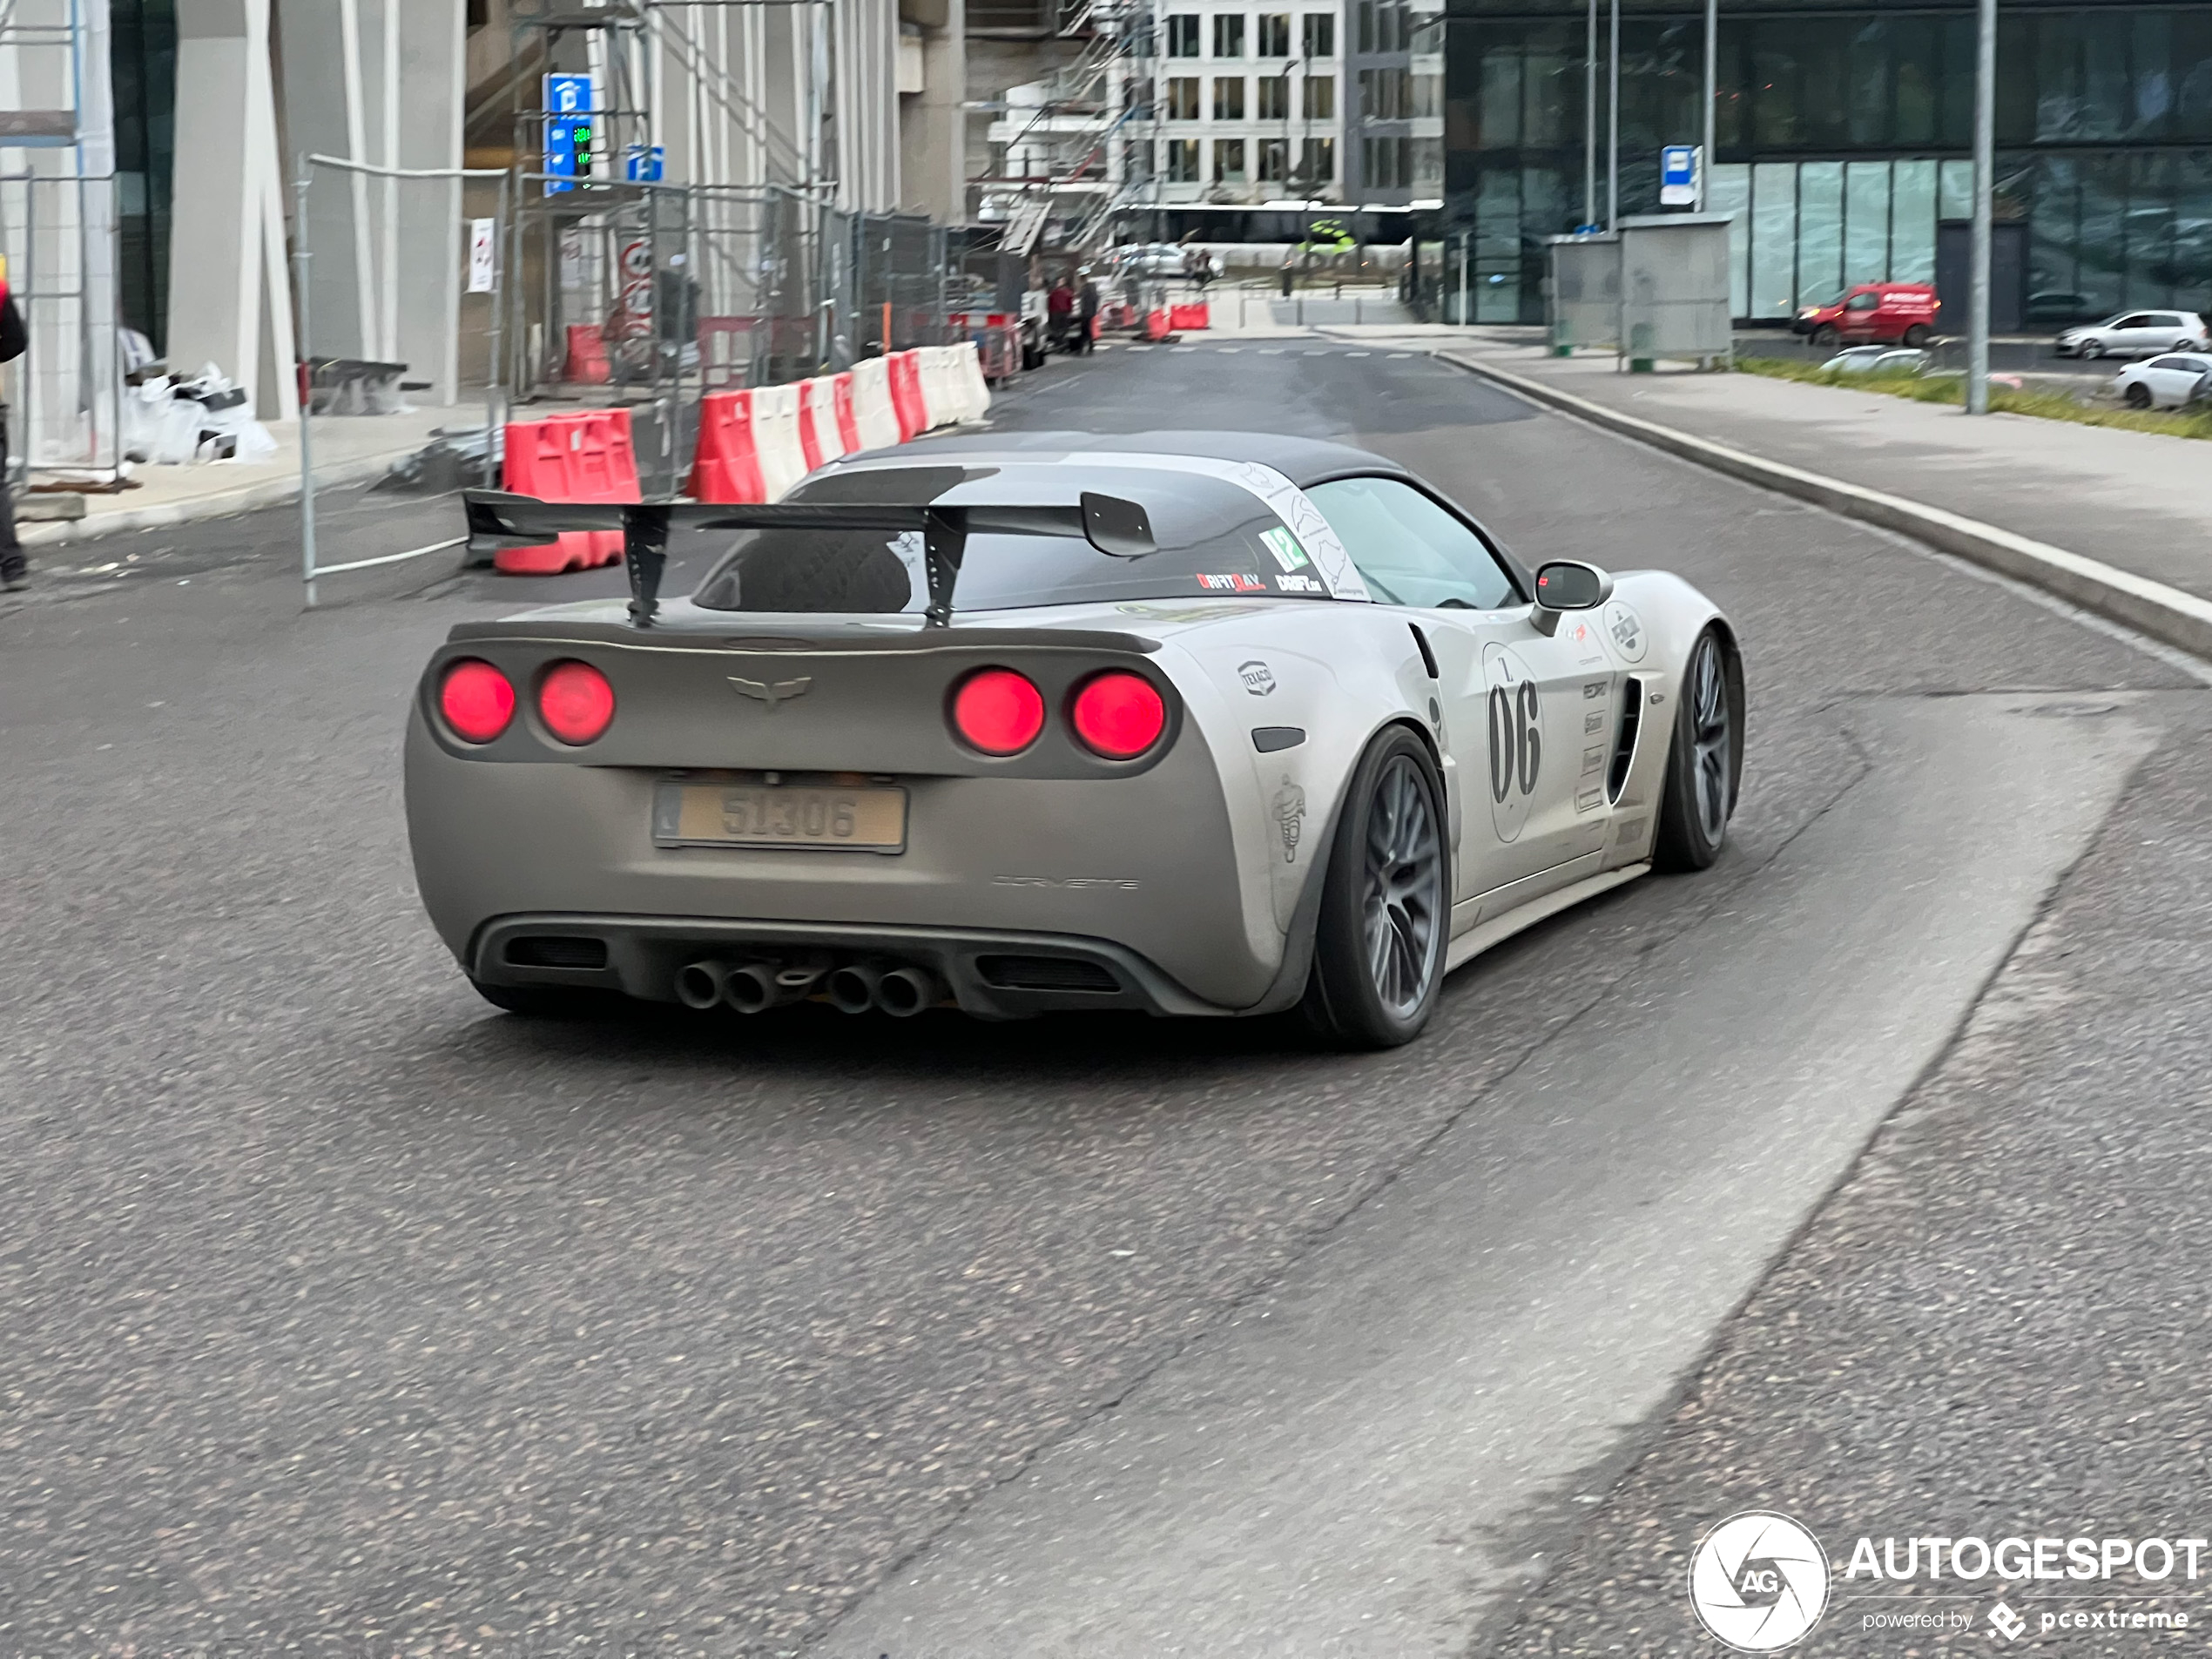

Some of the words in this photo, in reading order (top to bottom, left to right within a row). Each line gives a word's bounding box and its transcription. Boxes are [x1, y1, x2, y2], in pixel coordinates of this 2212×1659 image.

[1273, 529, 1306, 566] 2
[1196, 572, 1266, 593] DRIFTDAY
[1241, 668, 1272, 687] TEXACO
[1488, 679, 1541, 804] 06
[721, 790, 857, 838] 51306
